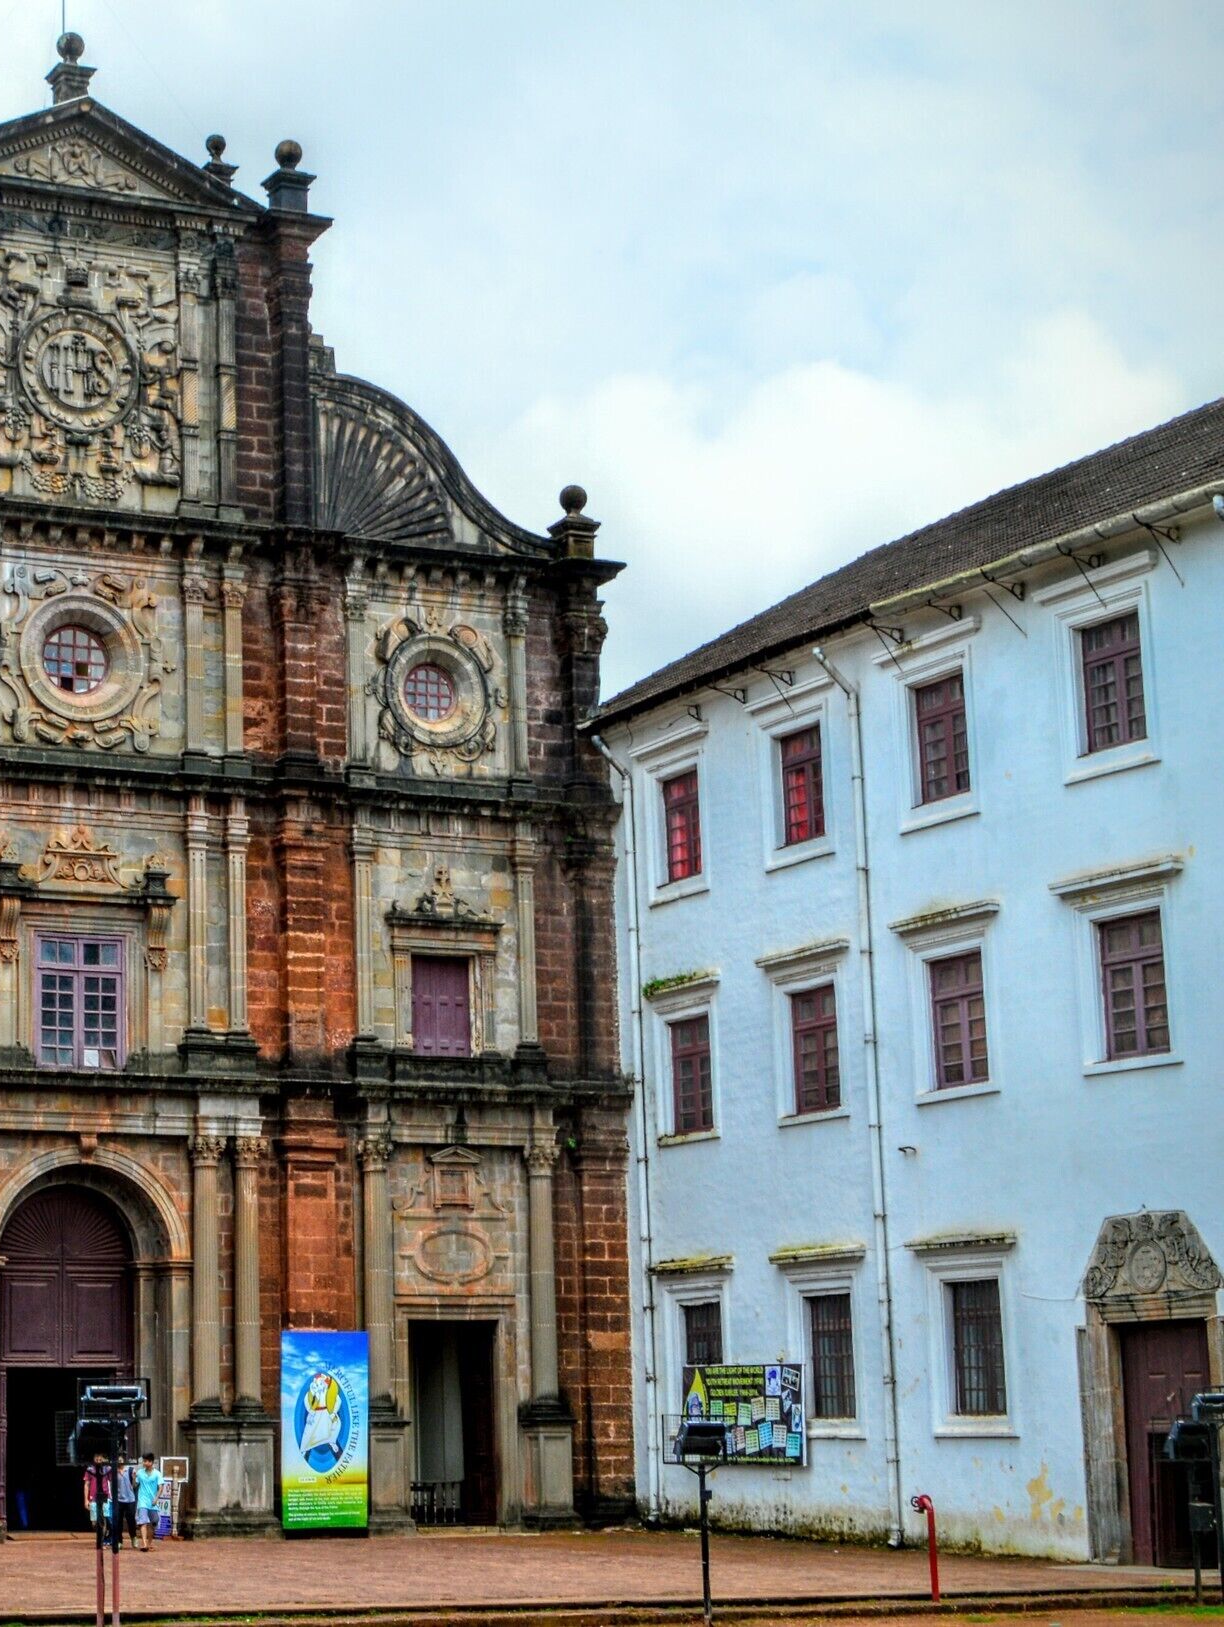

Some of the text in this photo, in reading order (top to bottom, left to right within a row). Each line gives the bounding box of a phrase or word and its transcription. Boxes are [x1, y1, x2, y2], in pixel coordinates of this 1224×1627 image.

[324, 1362, 359, 1485] MERCIFUL LIKE THE FATHER
